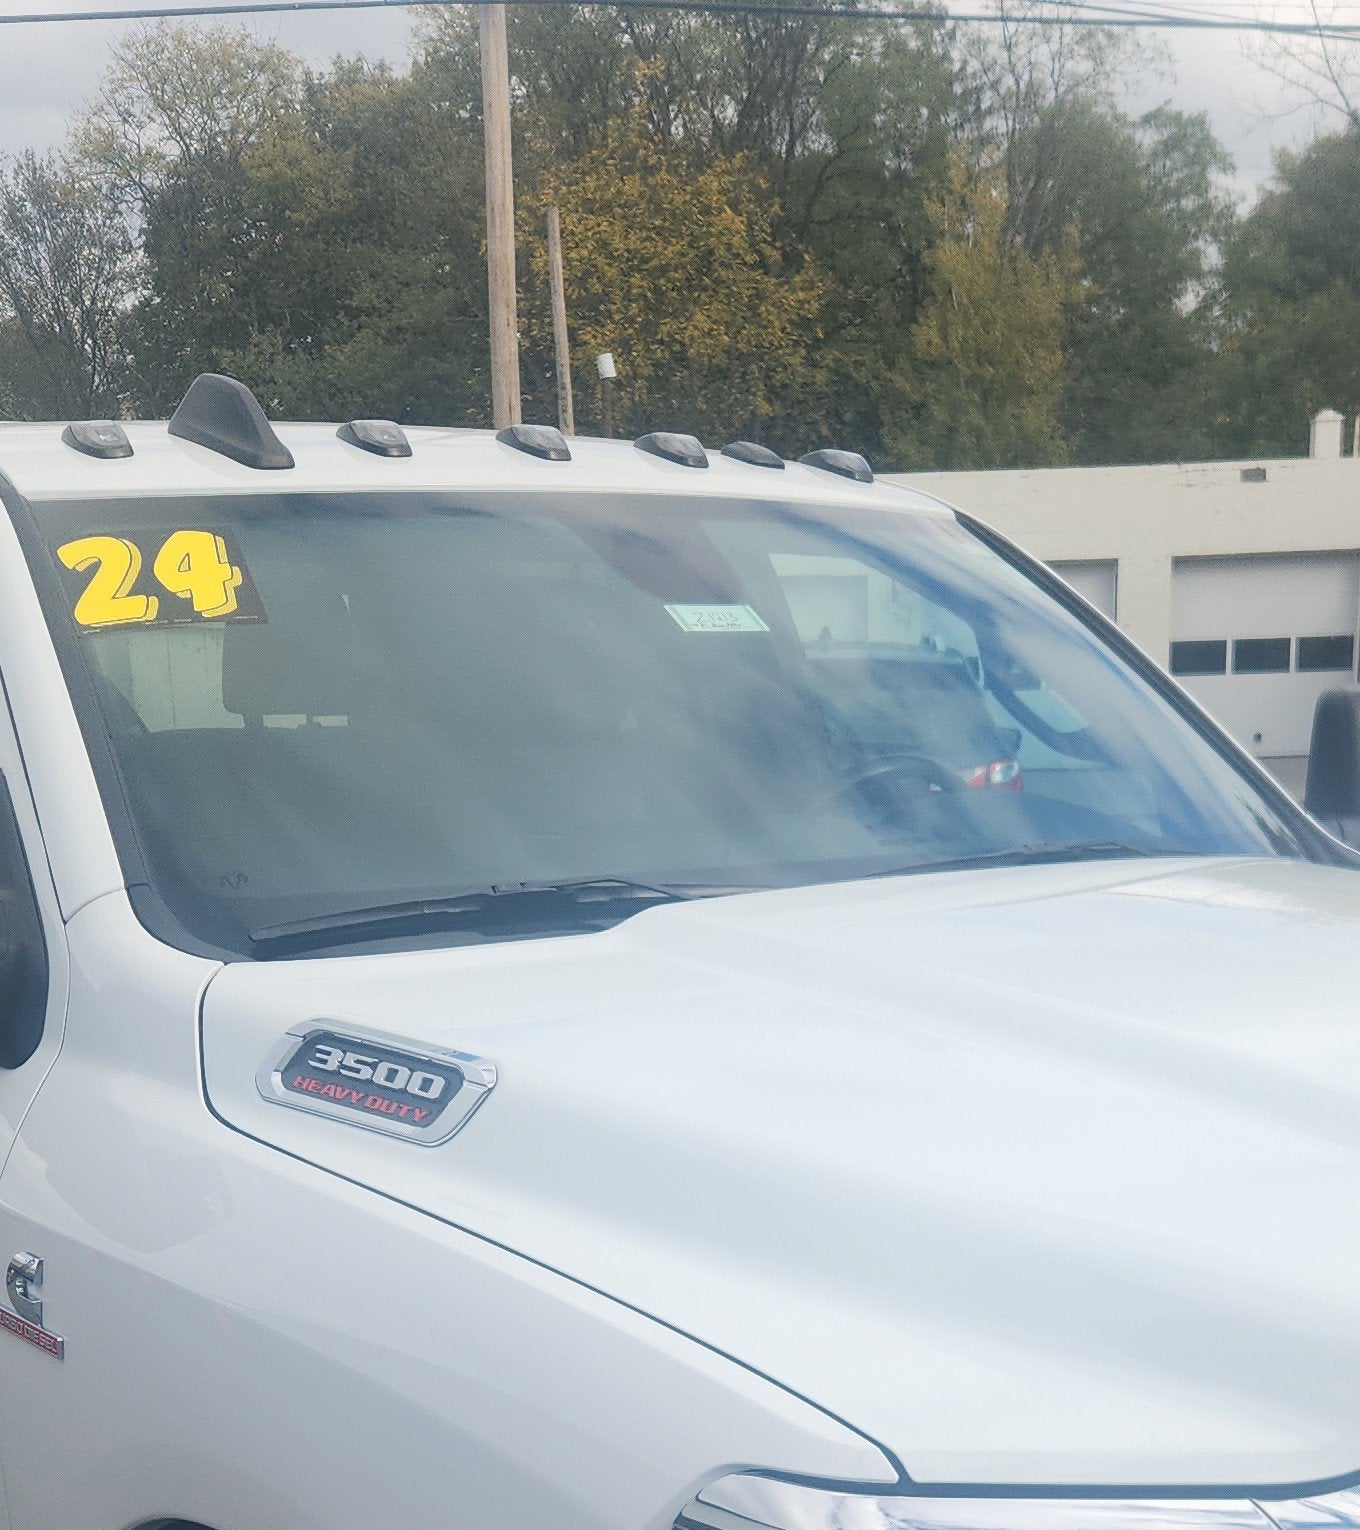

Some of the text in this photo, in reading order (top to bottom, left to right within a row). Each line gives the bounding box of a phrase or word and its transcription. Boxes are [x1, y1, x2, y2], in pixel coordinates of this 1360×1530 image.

[57, 530, 243, 626] 24
[293, 1075, 429, 1122] HEAVY DUTY
[308, 1045, 446, 1100] 3500
